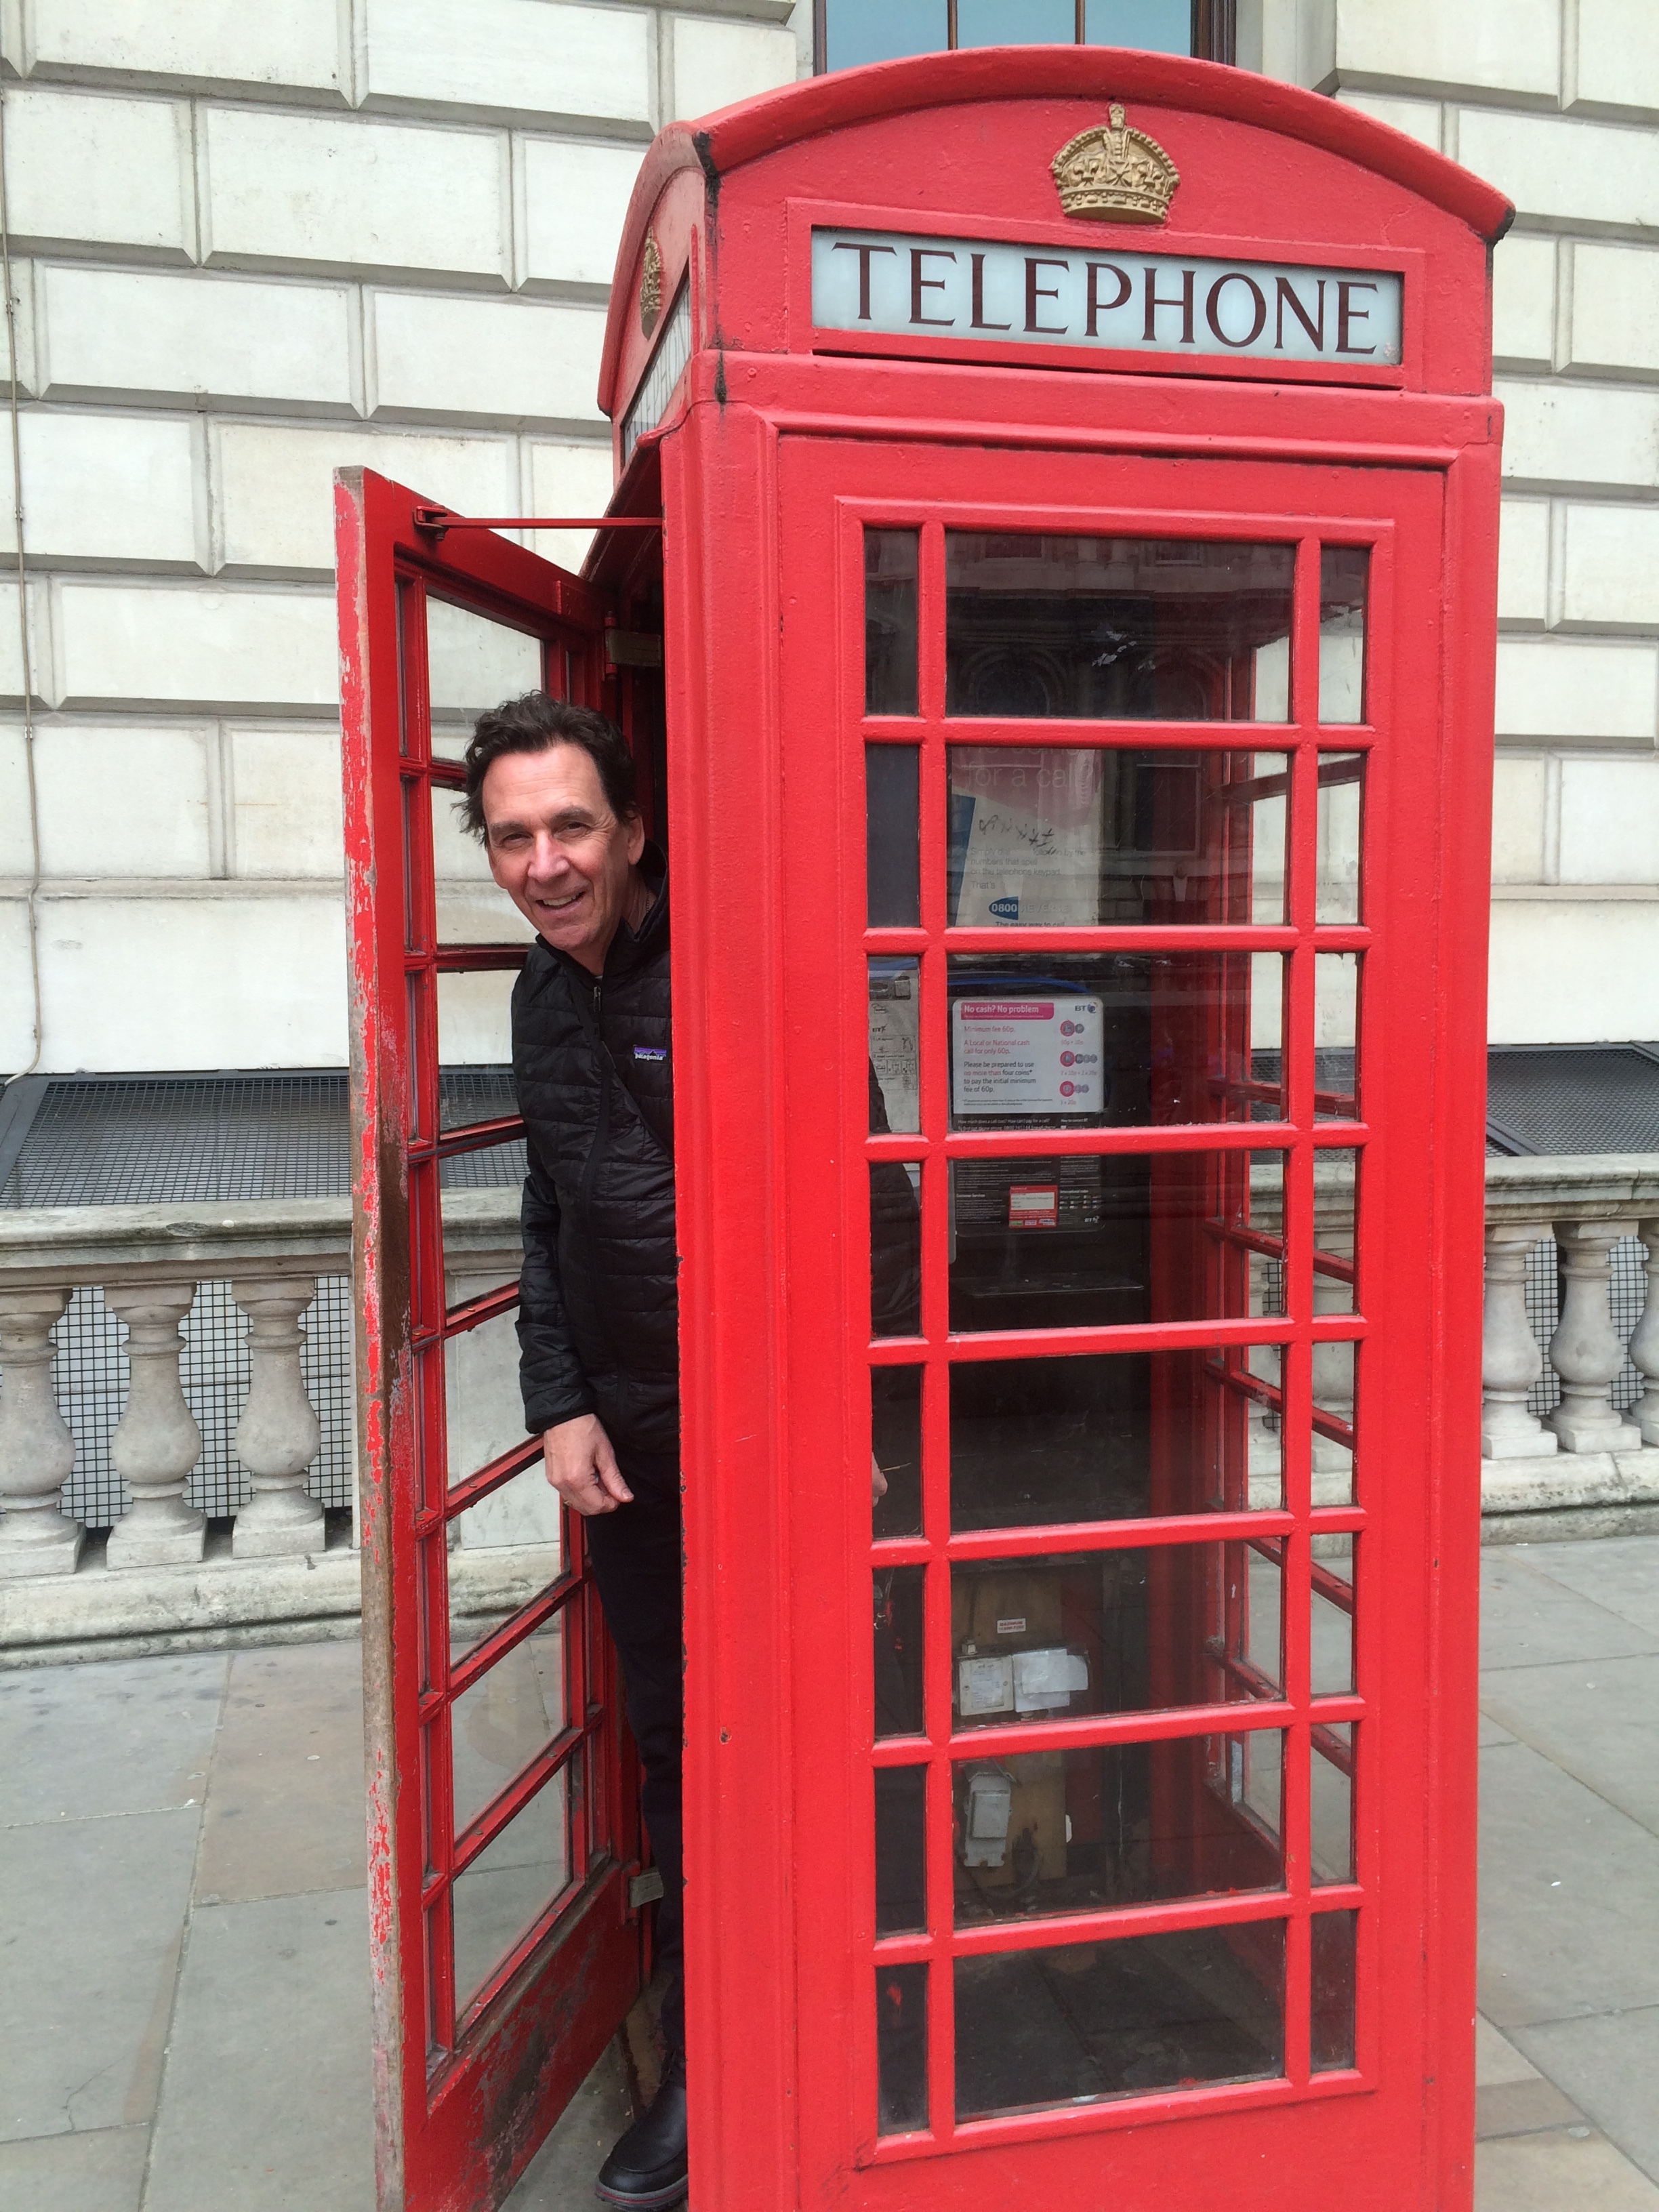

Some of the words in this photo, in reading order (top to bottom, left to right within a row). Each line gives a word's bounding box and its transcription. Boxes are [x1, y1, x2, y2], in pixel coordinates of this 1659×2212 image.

[832, 241, 1380, 355] TELEPHONE
[996, 867, 1033, 877] telephone
[970, 880, 996, 889] That's
[991, 903, 1017, 912] 0800
[976, 1005, 996, 1013] cash?
[1008, 1005, 1040, 1015] problem
